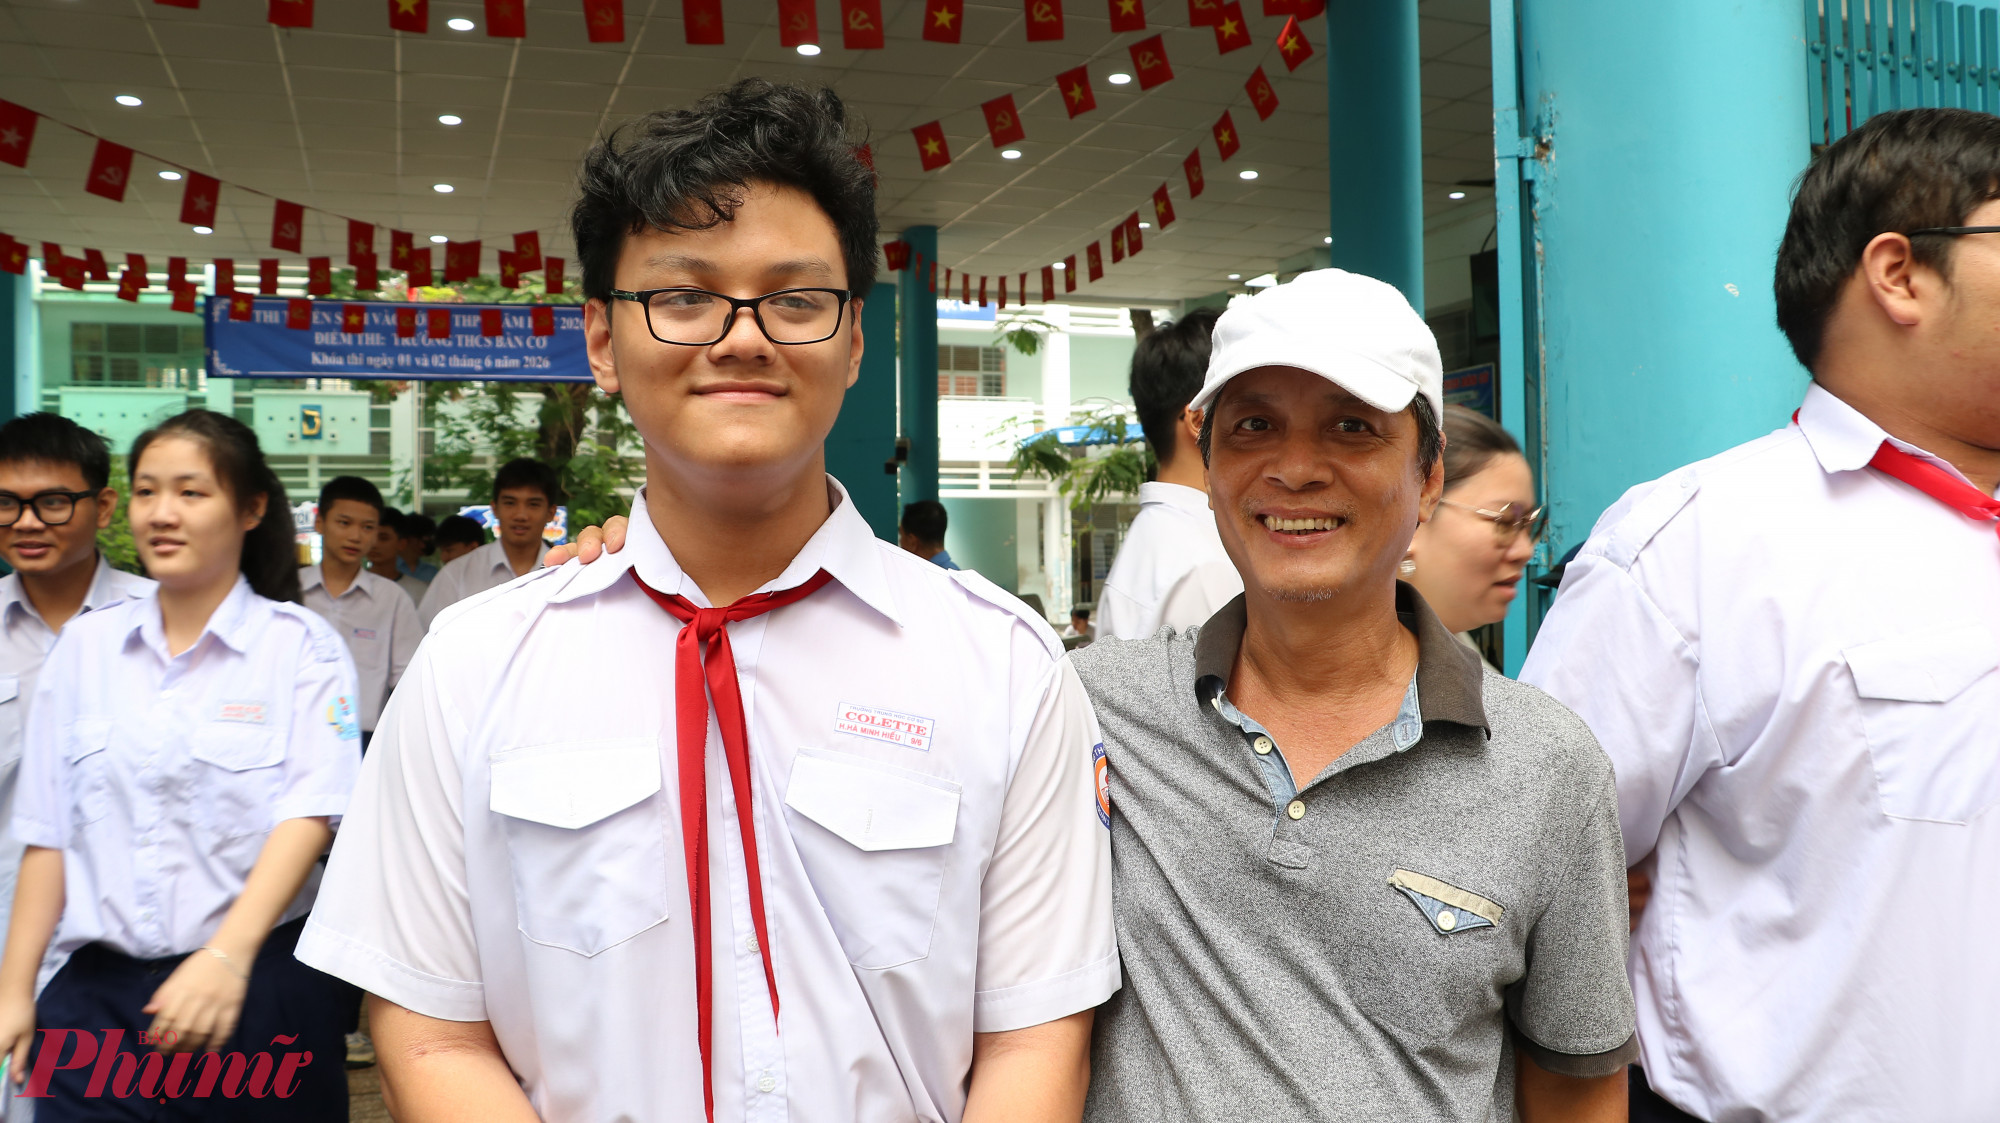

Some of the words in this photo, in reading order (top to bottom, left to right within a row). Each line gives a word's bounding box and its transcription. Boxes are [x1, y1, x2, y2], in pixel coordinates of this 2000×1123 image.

[253, 310, 280, 324] THI
[452, 313, 482, 328] THP
[502, 312, 525, 329] ĂM
[455, 334, 492, 348] THCS
[311, 351, 344, 365] Khóa
[347, 352, 364, 365] thi
[366, 353, 394, 369] ngày
[397, 353, 412, 367] 01
[414, 353, 429, 367] và
[431, 354, 446, 367] 02
[448, 354, 482, 371] tháng
[484, 355, 493, 368] 6
[494, 355, 520, 368] năm
[523, 355, 551, 369] 2026
[845, 711, 927, 736] COLETTE
[860, 726, 880, 737] MINH
